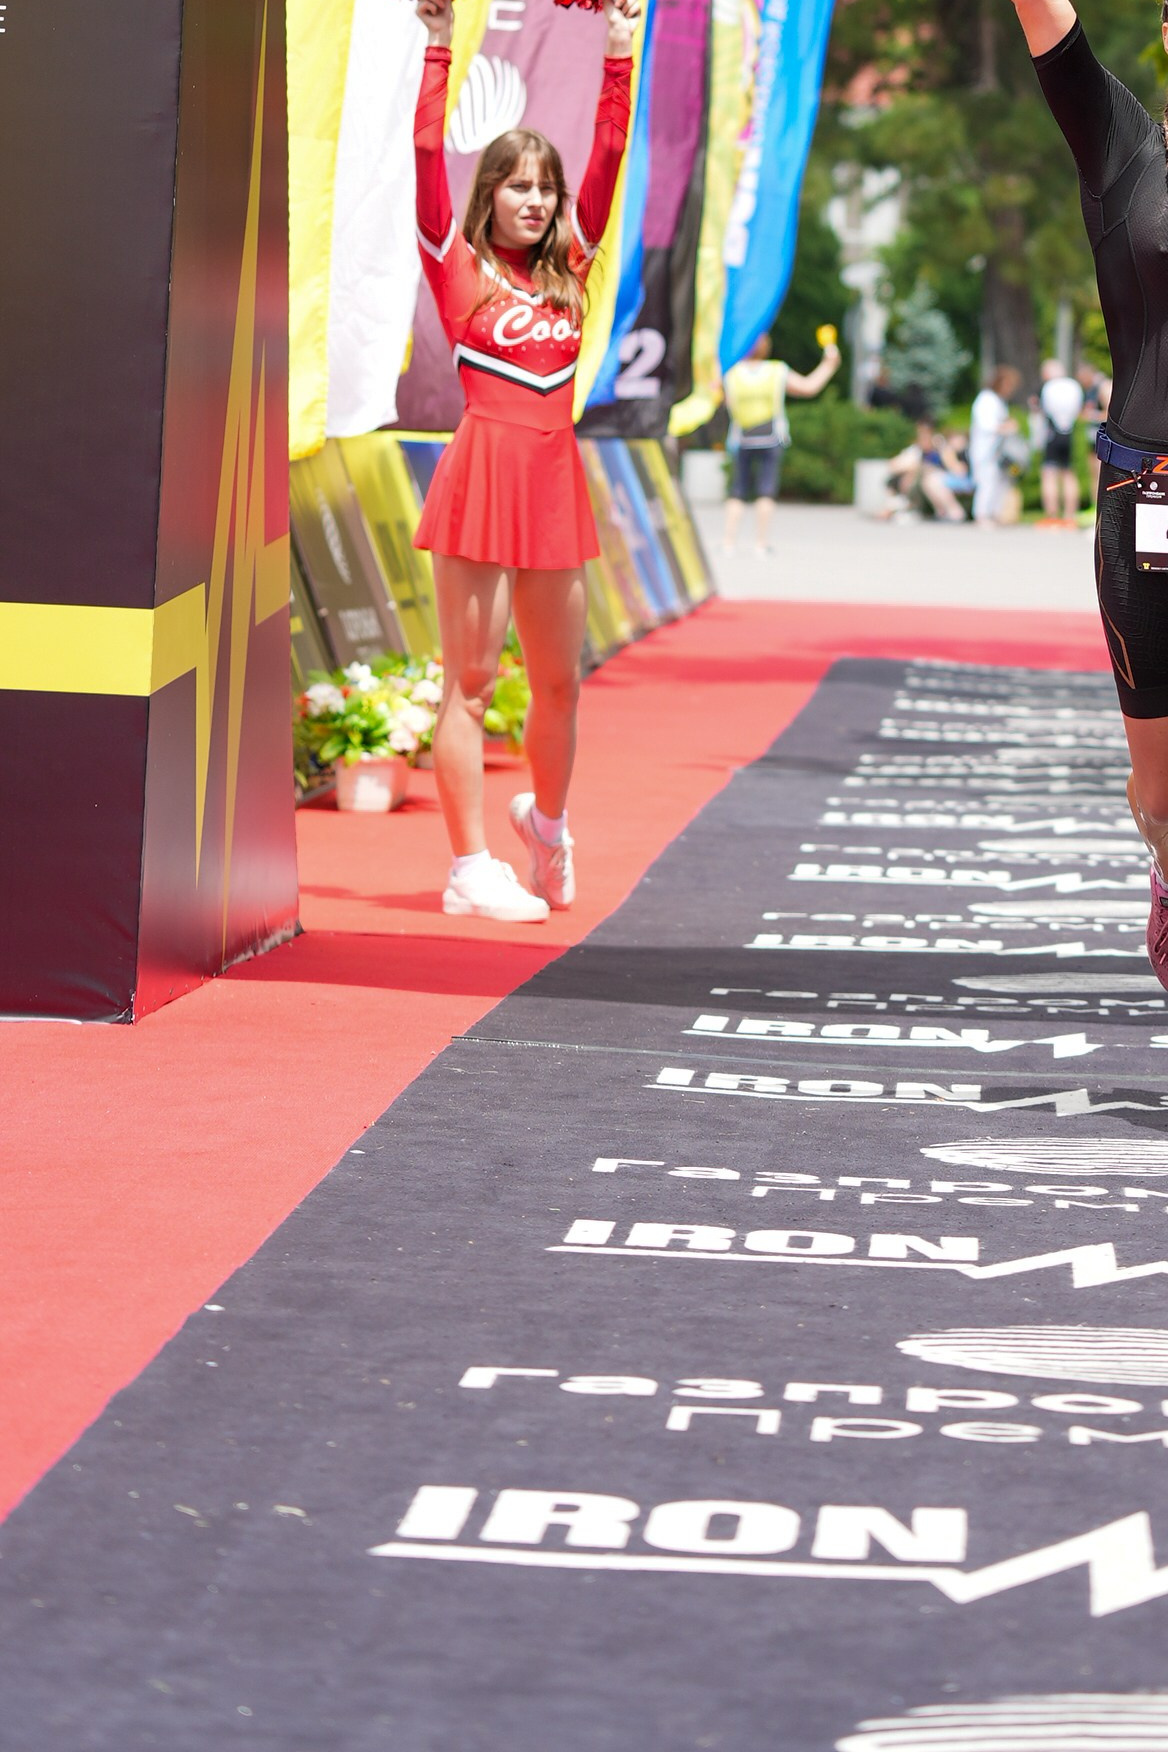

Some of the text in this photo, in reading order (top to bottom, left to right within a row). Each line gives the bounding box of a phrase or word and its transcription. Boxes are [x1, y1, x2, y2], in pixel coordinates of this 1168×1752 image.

[493, 305, 581, 347] Coo
[692, 1014, 990, 1042] IRON
[656, 1067, 982, 1102] IRON
[563, 1219, 980, 1261] IRON
[396, 1484, 968, 1563] IRON
